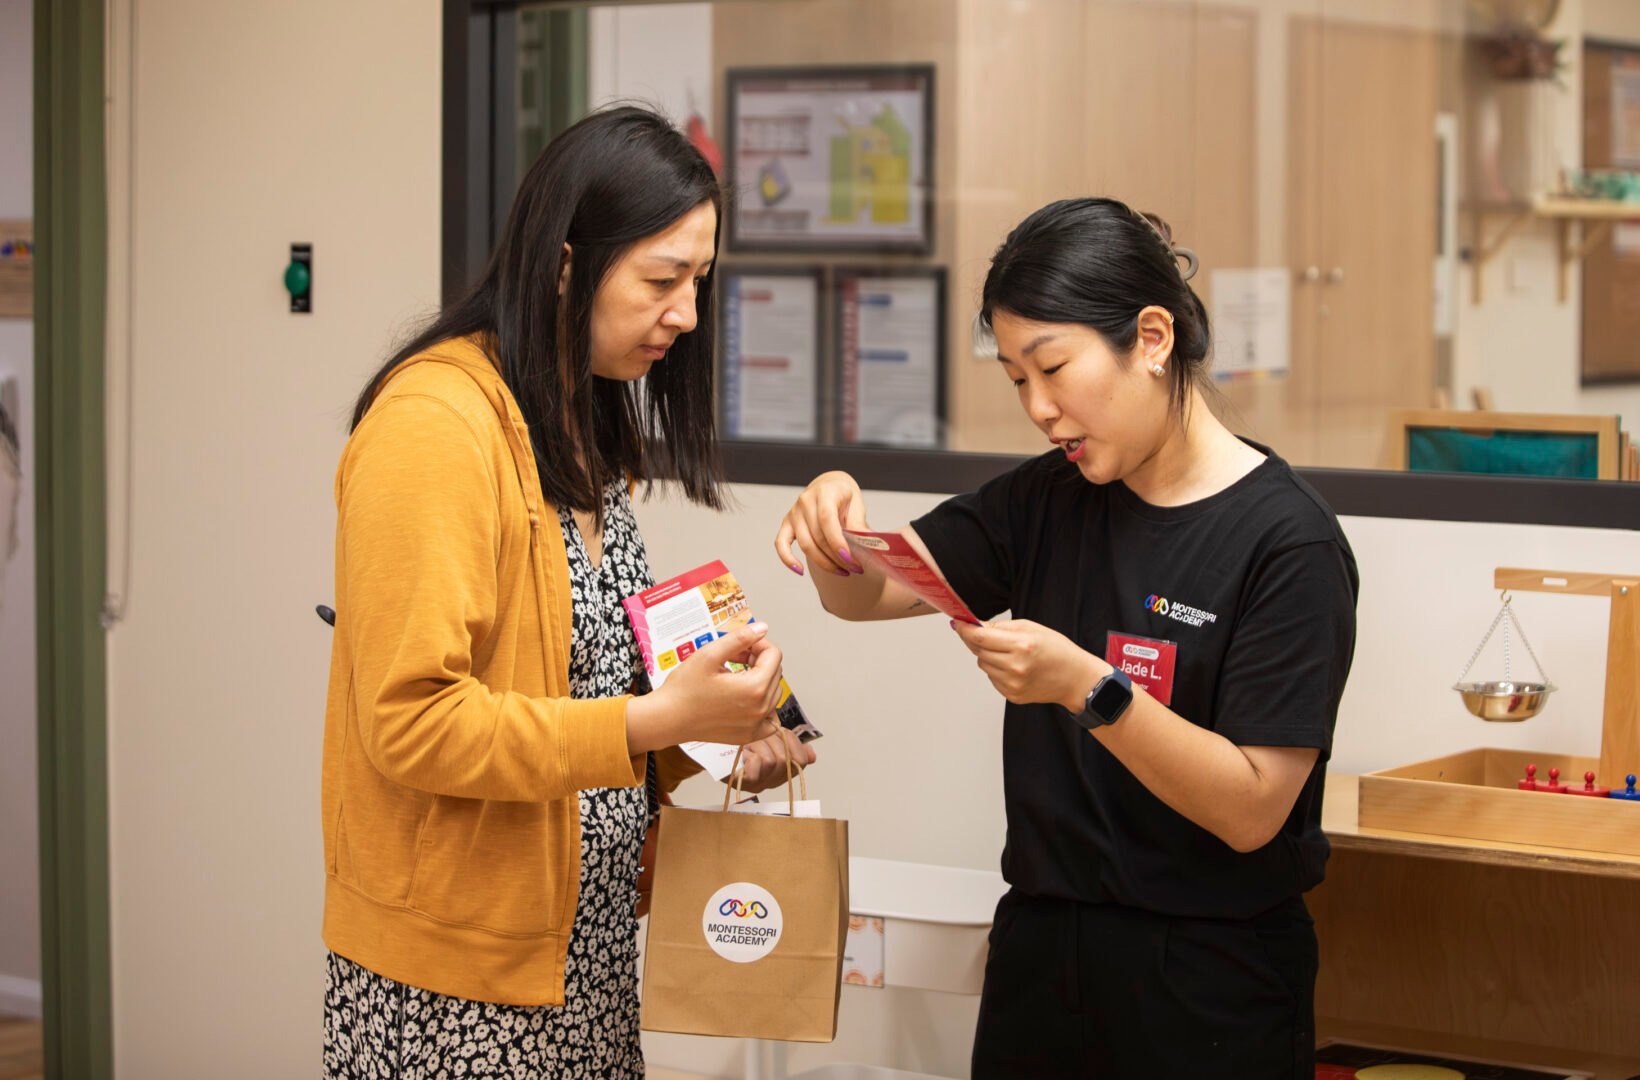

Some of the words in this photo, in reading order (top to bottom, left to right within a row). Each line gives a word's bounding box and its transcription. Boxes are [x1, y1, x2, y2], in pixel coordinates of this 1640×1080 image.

[1168, 610, 1205, 627] ACADEMY
[1171, 601, 1217, 623] MONTESSORI
[1118, 659, 1148, 677] Jade
[1150, 665, 1162, 680] L.
[708, 923, 777, 937] MONTESSORI
[715, 934, 767, 946] ACADEMY
